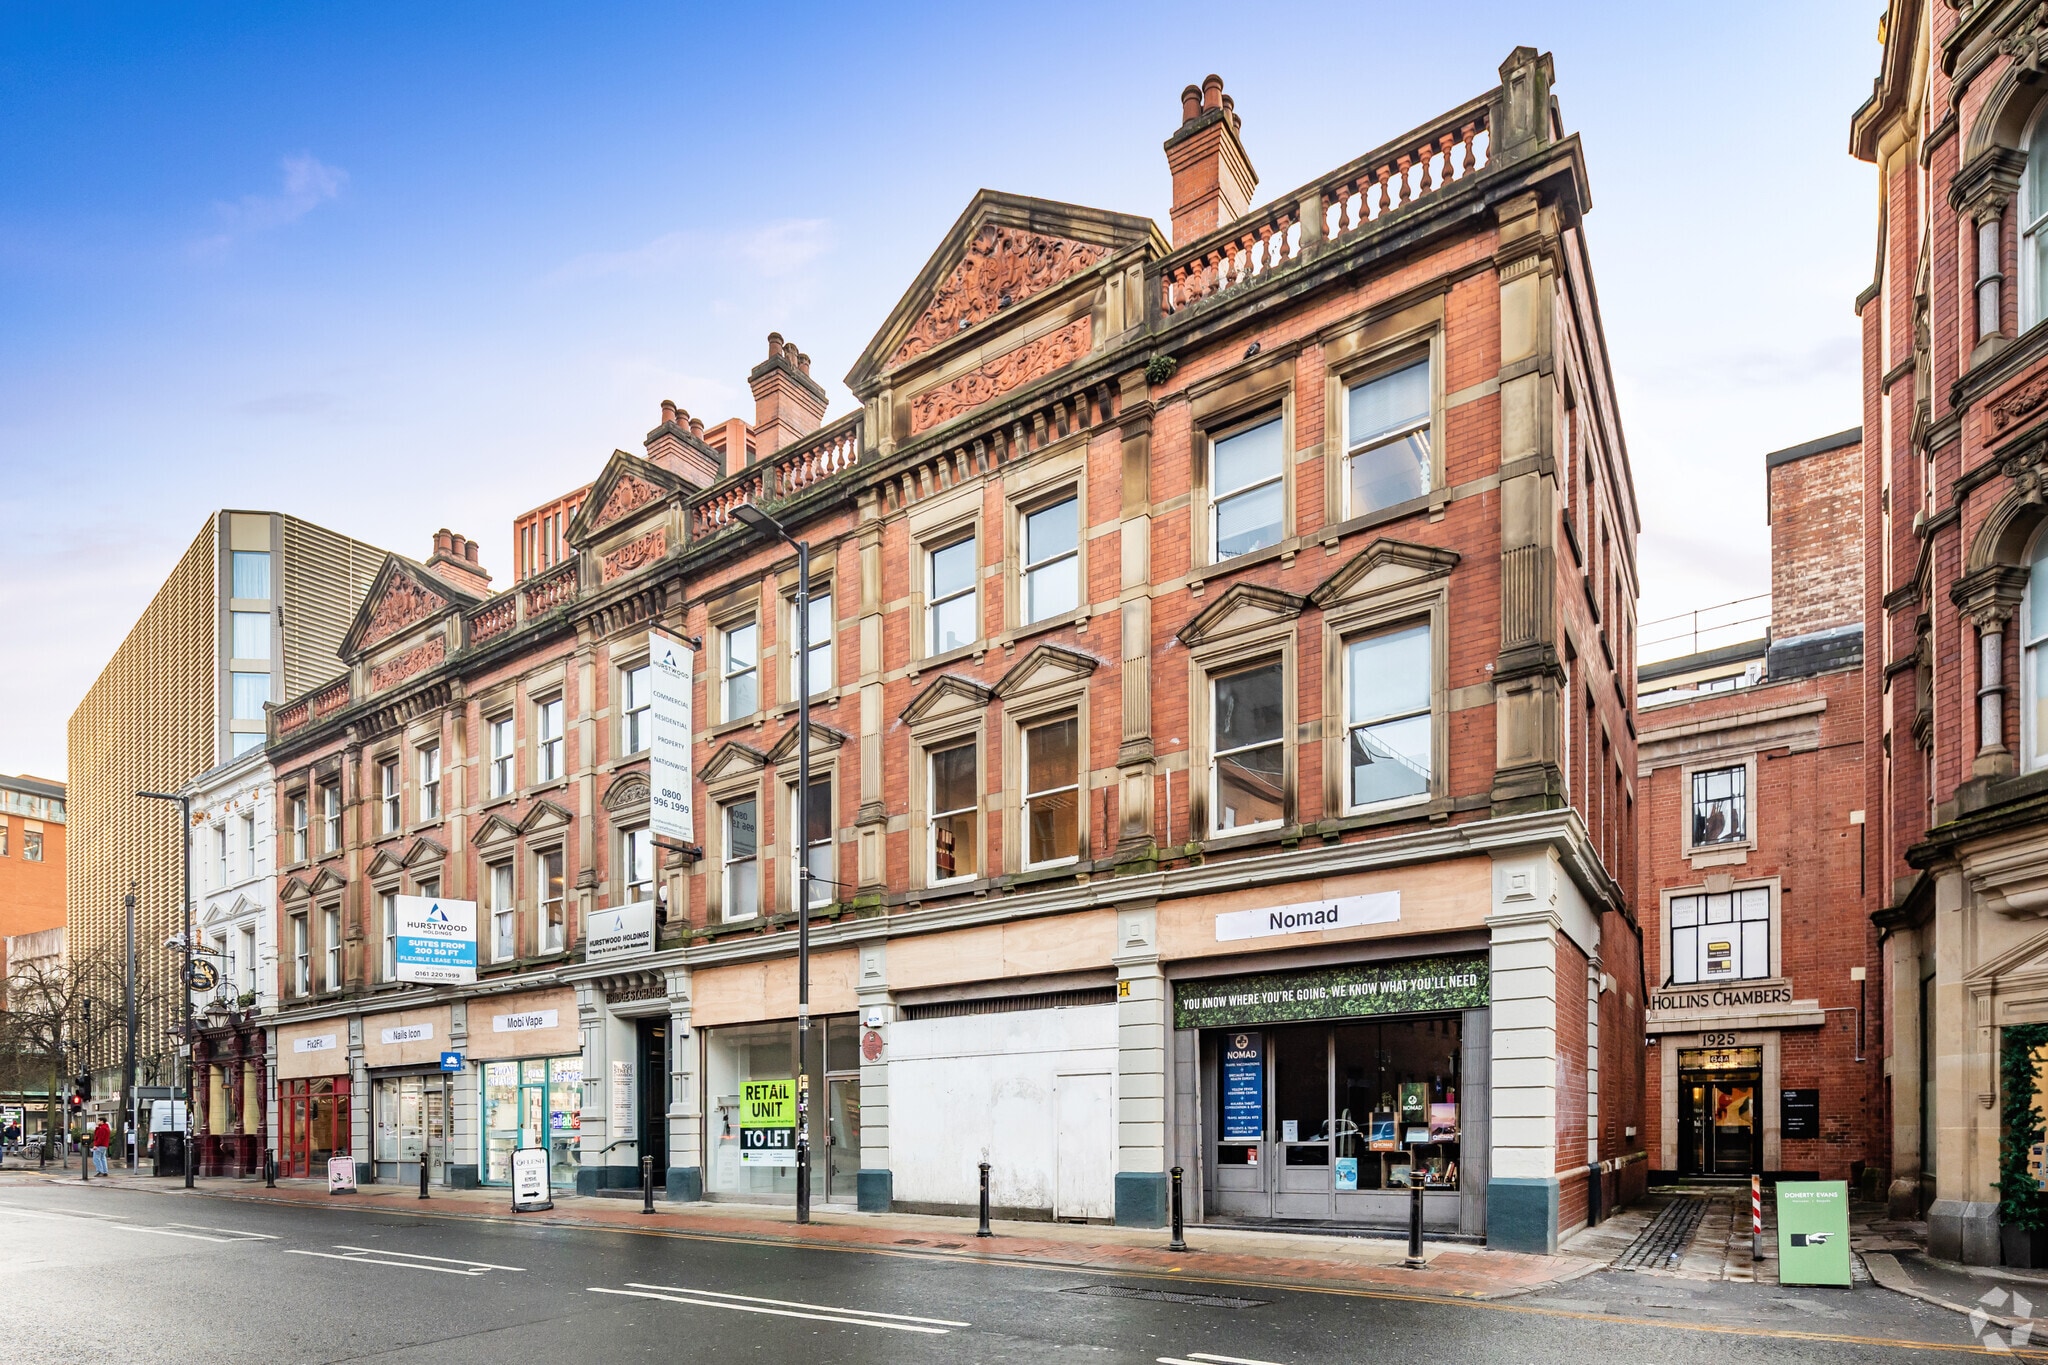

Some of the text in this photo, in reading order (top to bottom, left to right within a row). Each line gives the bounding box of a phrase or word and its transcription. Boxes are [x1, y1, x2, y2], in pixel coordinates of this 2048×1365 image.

[653, 660, 689, 679] HURSTWOOD
[653, 691, 688, 709] COMMERCIAL
[655, 713, 687, 730] RESIDENTIAL
[658, 736, 684, 750] PROPERTY
[654, 757, 688, 773] NATIONWIDE
[662, 788, 682, 801] 0800
[654, 797, 689, 814] 996 1999
[1270, 905, 1338, 929] Nomad
[407, 922, 467, 932] HURSTWOOD
[409, 940, 439, 948] SUITES
[589, 931, 649, 947] HURSTWOOD HOLDINGS
[1119, 982, 1130, 997] H
[1184, 974, 1477, 1010] YOU KNOW WHERE YOU'RE GOING, WE KNOW WHAT YOU'LL NEED
[1652, 989, 1791, 1010] HOLLINS CHAMBERS
[507, 1016, 543, 1028] Mobi Vape
[393, 1029, 421, 1040] Nails Icon
[1703, 1033, 1735, 1046] 1925
[307, 1039, 323, 1049] Fix2Fit
[1227, 1050, 1257, 1059] NOMAD
[493, 1066, 515, 1076] PHONE
[746, 1084, 789, 1100] RETAIL
[752, 1102, 782, 1117] UNIT
[745, 1130, 790, 1147] TO LET
